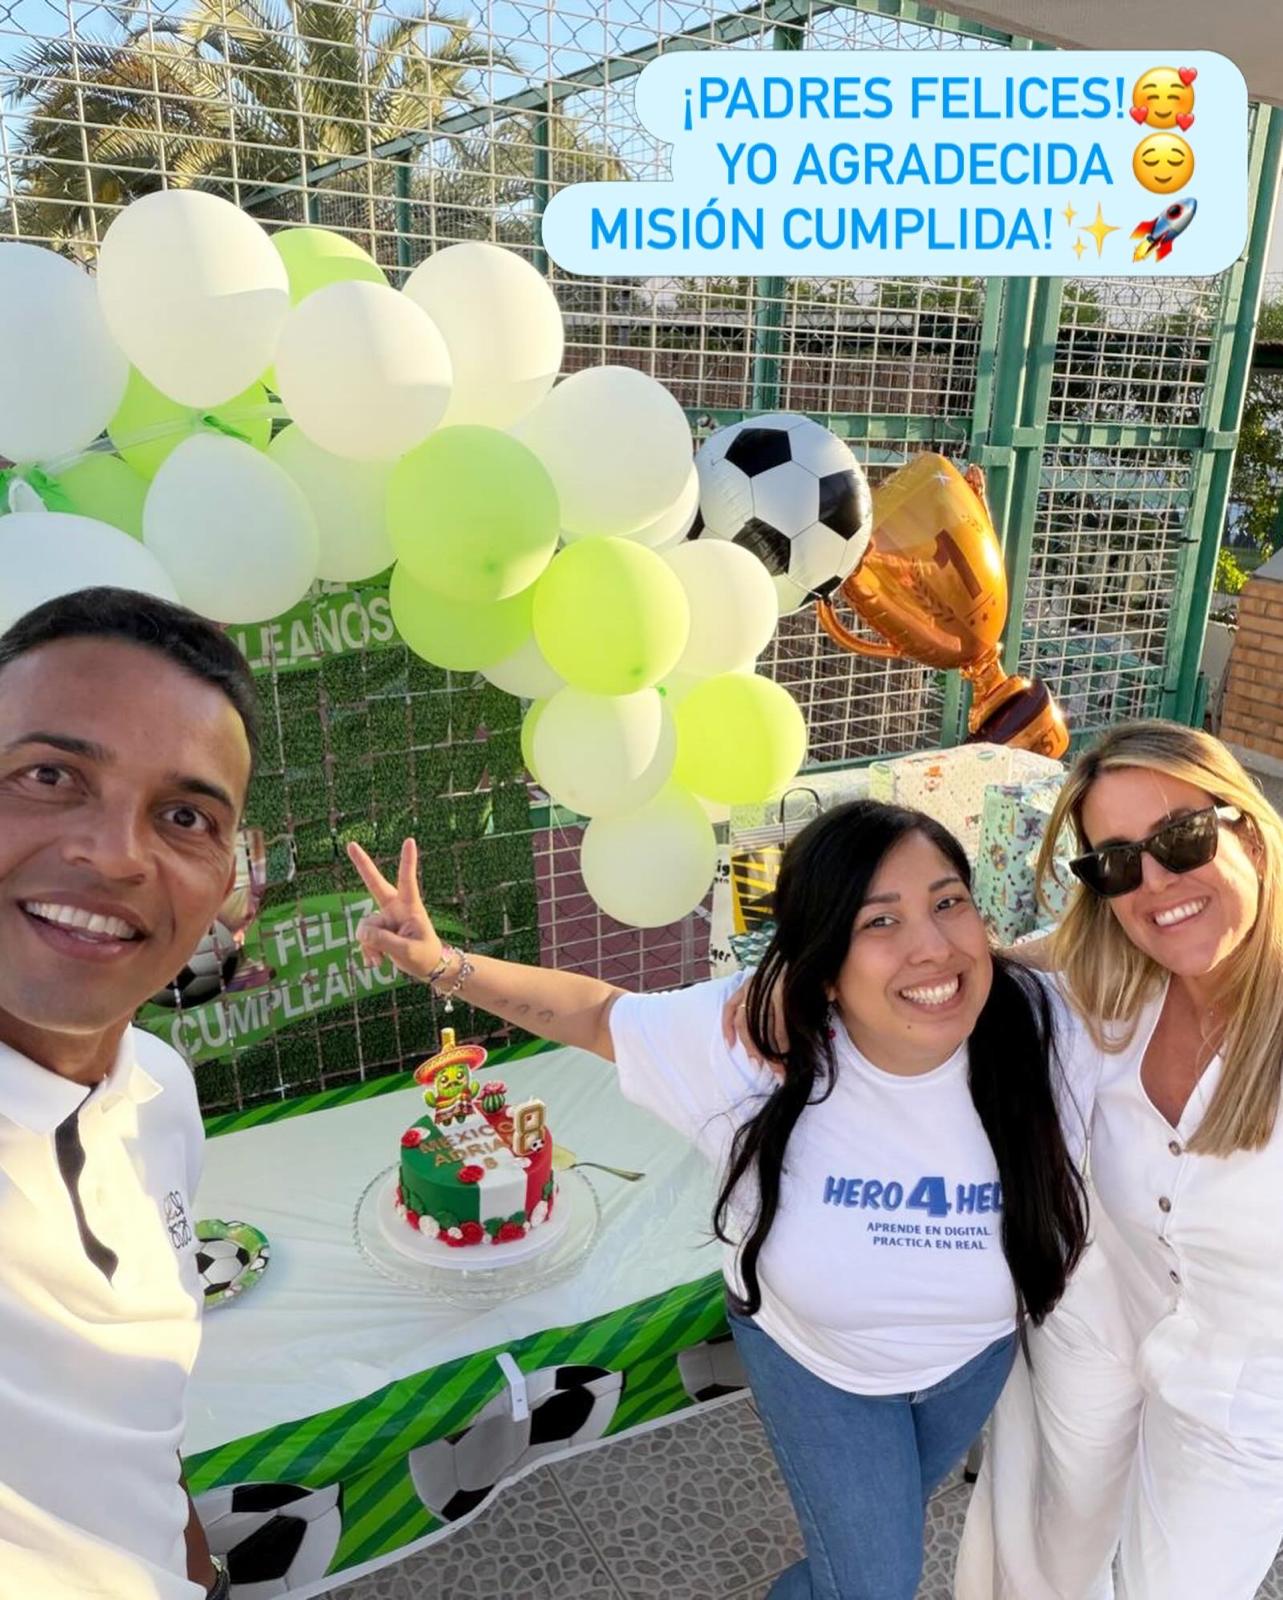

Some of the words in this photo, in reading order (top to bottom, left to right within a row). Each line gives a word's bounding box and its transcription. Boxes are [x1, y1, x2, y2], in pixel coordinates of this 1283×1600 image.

[435, 1136, 514, 1167] ADRIA
[956, 1182, 1003, 1214] HEL
[867, 1222, 921, 1234] APRENDE
[925, 1225, 941, 1236] EN
[873, 1236, 932, 1248] PRACTICA
[935, 1239, 951, 1249] EN
